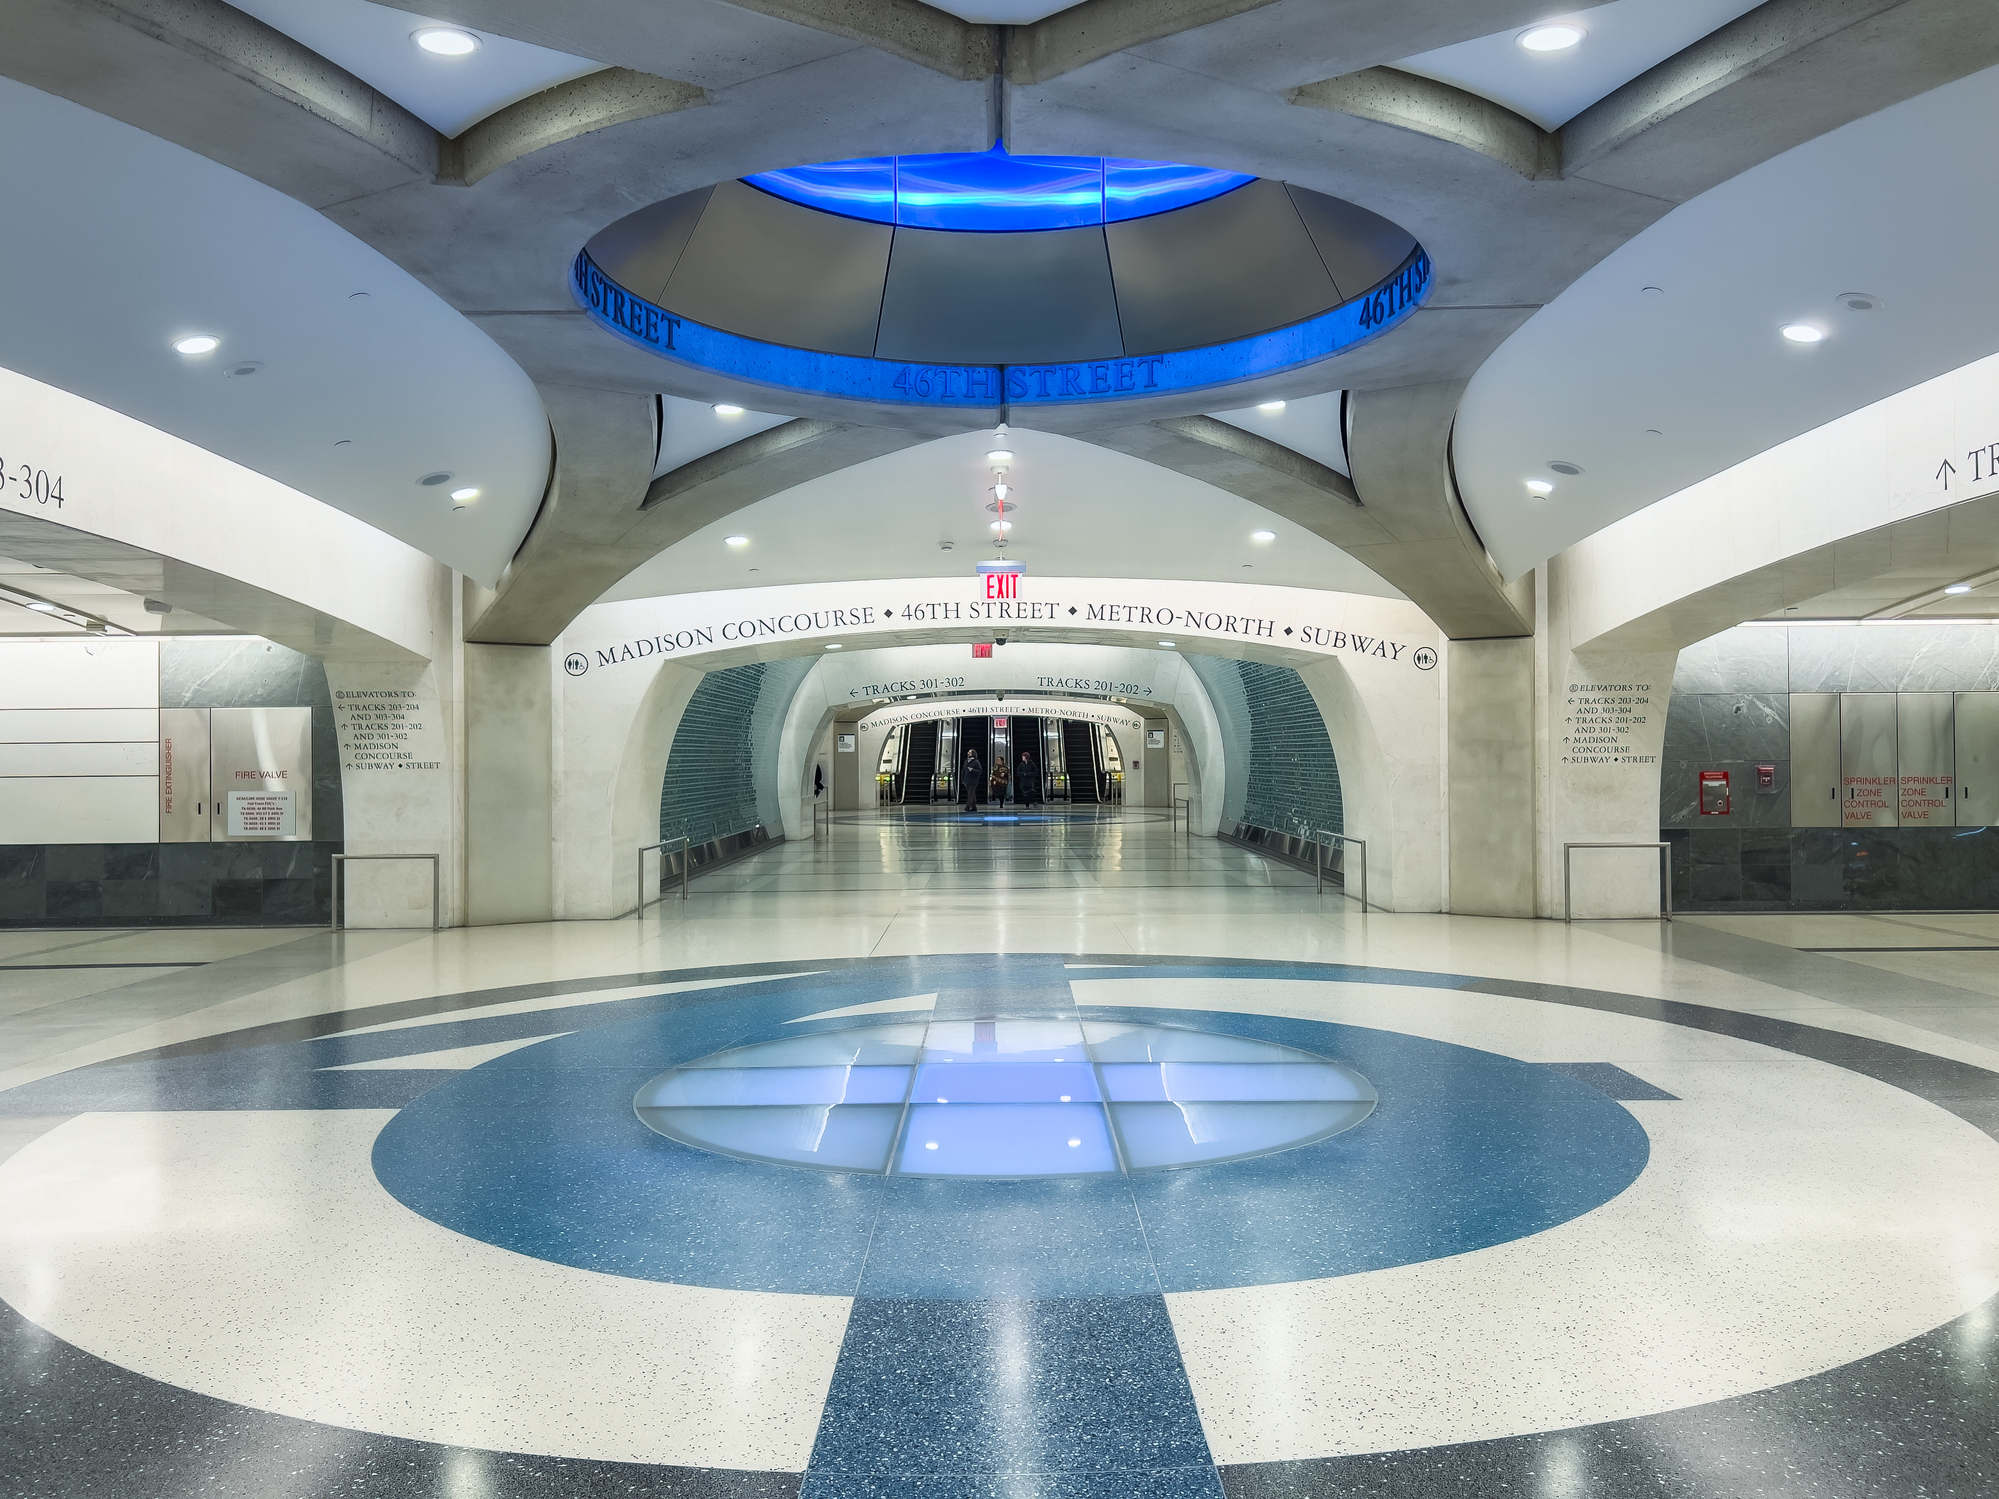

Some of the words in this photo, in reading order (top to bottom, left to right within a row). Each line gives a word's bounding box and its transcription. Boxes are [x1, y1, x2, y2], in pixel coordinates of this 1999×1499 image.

[1359, 264, 1413, 329] 46TH
[591, 271, 680, 351] STREET
[893, 366, 996, 399] 46TH
[1008, 356, 1163, 398] STREET
[986, 574, 1019, 599] EXIT
[595, 626, 715, 669] MADISON
[722, 606, 875, 642] CONCOURSE
[901, 601, 961, 621] 46TH
[969, 601, 1060, 620] STREET
[1085, 603, 1276, 638] METRO-NORTH
[1301, 625, 1408, 662] SUBWAY
[862, 680, 916, 696] TRACKS
[920, 676, 965, 690] 301-302
[1037, 676, 1090, 690] TRACKS
[1094, 680, 1139, 695] 201-202
[1579, 684, 1633, 692] ELEVATORS
[345, 690, 399, 698] ELEVATORS
[1578, 697, 1616, 705] TRACKS
[1617, 697, 1649, 705] 203-204
[348, 703, 386, 711] TRACKS
[388, 703, 420, 711] 203-204
[1576, 707, 1599, 715] AND
[350, 713, 372, 721] AND
[374, 713, 405, 721] 303-304
[870, 714, 909, 728] MADISON
[910, 708, 960, 720] CONCOURSE
[968, 706, 988, 714] 46TH
[1096, 714, 1130, 727] SUBWAY
[1575, 716, 1613, 724] TRACKS
[1615, 716, 1647, 724] 201-202
[351, 723, 389, 731] TRACKS
[1574, 726, 1596, 734] AND
[1598, 726, 1630, 734] 301-302
[1573, 736, 1618, 744] MADISON
[354, 742, 399, 750] MADISON
[1572, 746, 1631, 754] CONCOURSE
[354, 752, 413, 760] CONCOURSE
[1571, 756, 1611, 764] SUBWAY
[1621, 756, 1657, 764] STREET
[165, 738, 173, 795] EXTINGUISHER
[355, 762, 395, 770] SUBWAY
[405, 762, 441, 770] STREET
[235, 770, 256, 780] FIRE
[258, 770, 288, 779] VALVE
[1843, 776, 1896, 786] SPRINKLER
[1900, 776, 1953, 785] SPRINKLER
[1856, 788, 1883, 797] ZONE
[1901, 787, 1927, 796] ZONE
[165, 796, 173, 814] FIRE
[1843, 799, 1889, 809] CONTROL
[1900, 799, 1947, 808] CONTROL
[1843, 811, 1872, 820] VALVE
[1901, 810, 1929, 819] VALVE
